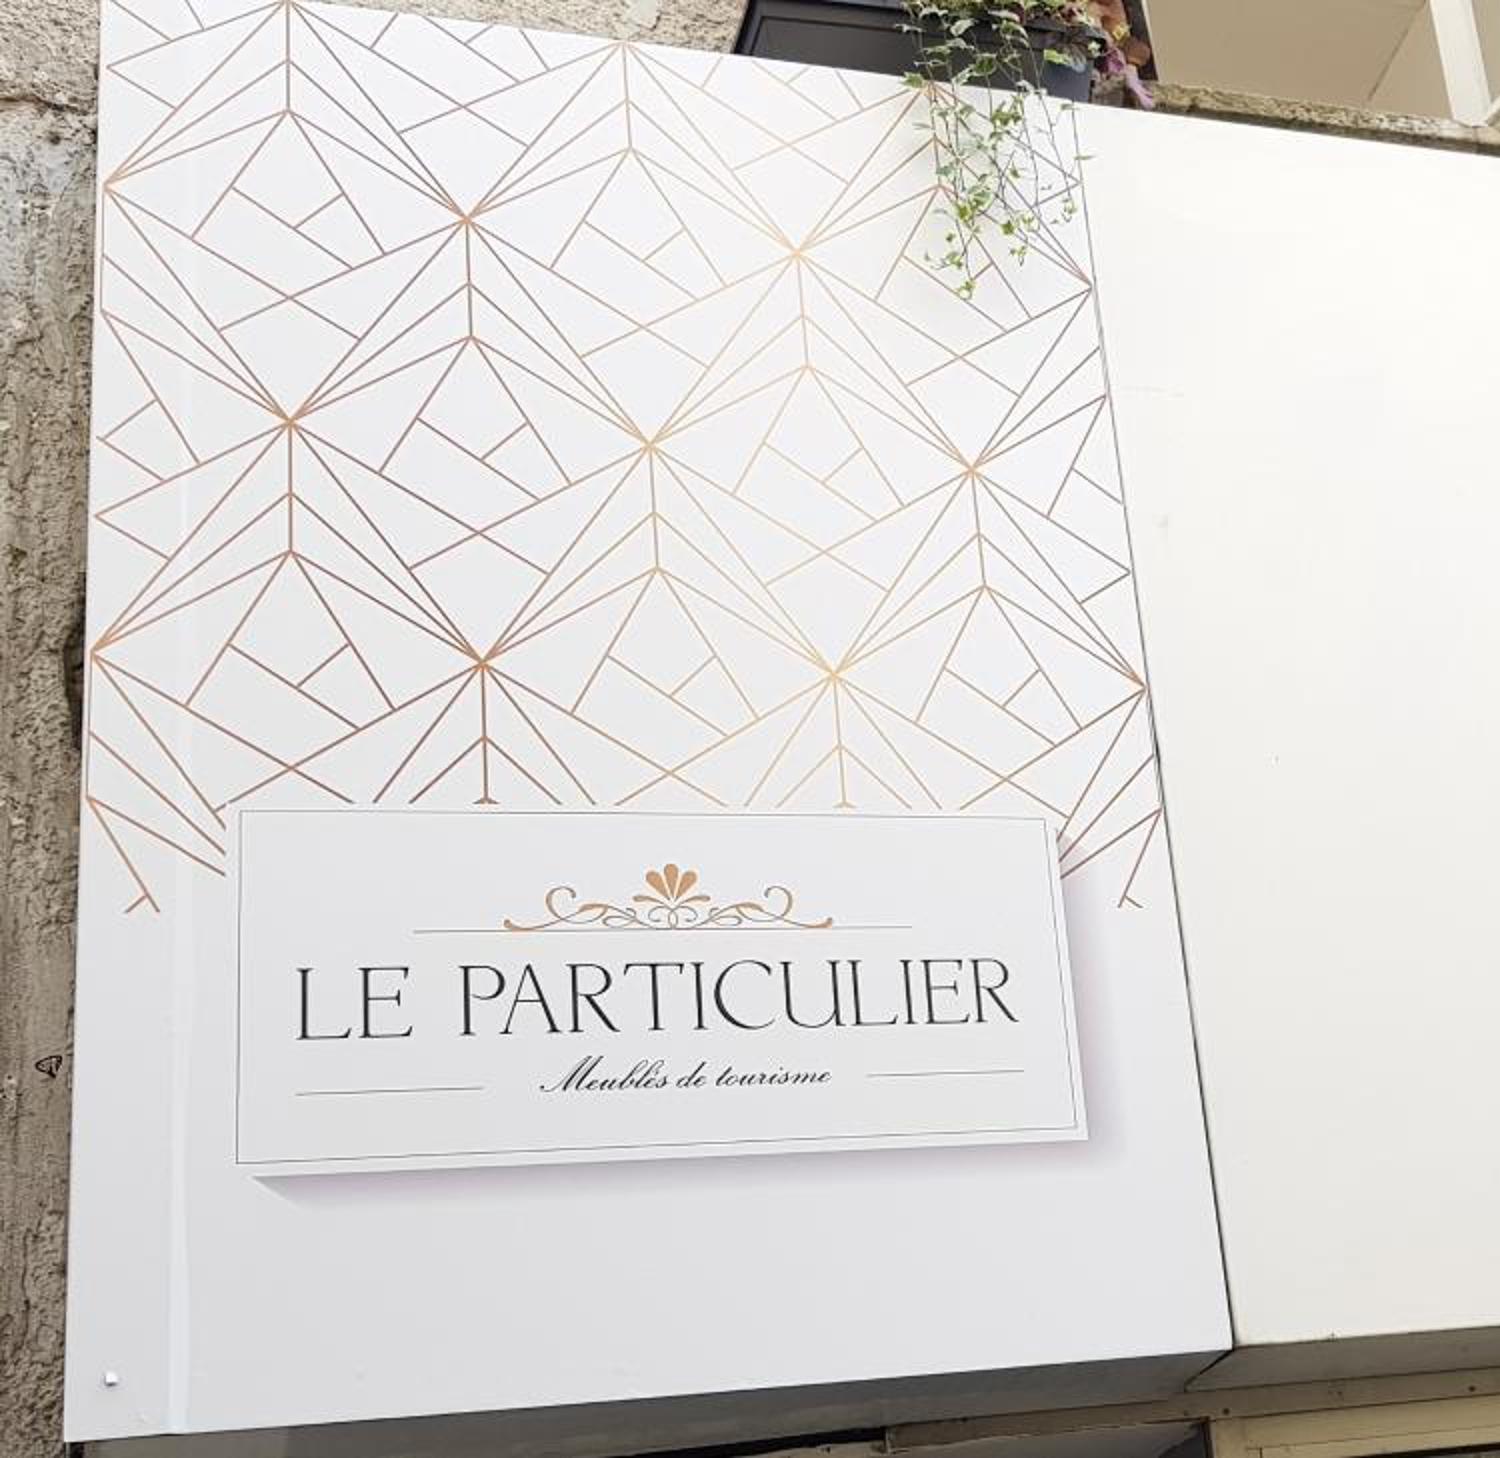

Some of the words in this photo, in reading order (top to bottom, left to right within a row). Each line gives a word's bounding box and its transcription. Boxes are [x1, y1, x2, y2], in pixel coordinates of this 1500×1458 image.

[297, 966, 413, 1041] LE
[458, 959, 1019, 1036] PARTICULIER
[675, 1061, 706, 1089] de
[715, 1066, 830, 1087] tourisme
